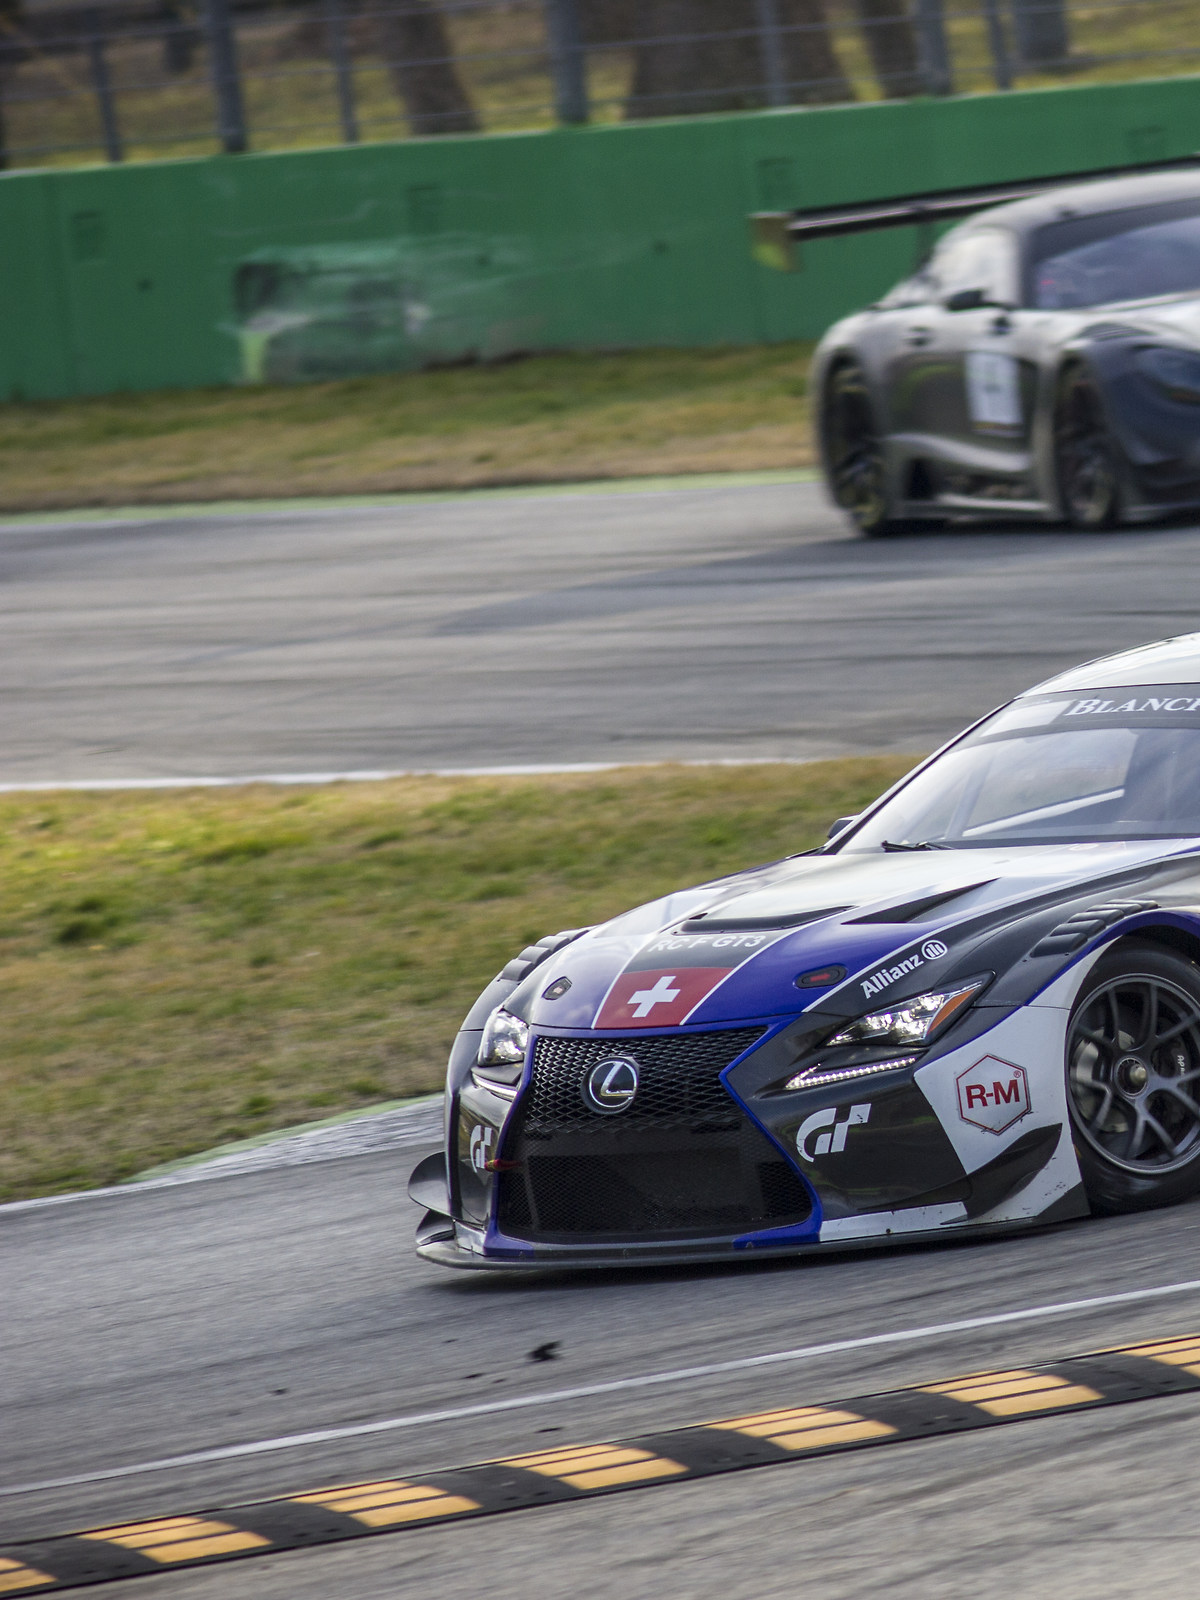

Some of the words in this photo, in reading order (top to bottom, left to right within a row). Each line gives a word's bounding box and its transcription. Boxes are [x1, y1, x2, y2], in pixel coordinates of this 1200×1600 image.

[648, 938, 689, 952] RC
[688, 936, 714, 949] F
[711, 935, 766, 948] GT3
[859, 954, 924, 999] Allianz
[965, 1079, 1021, 1109] R-M
